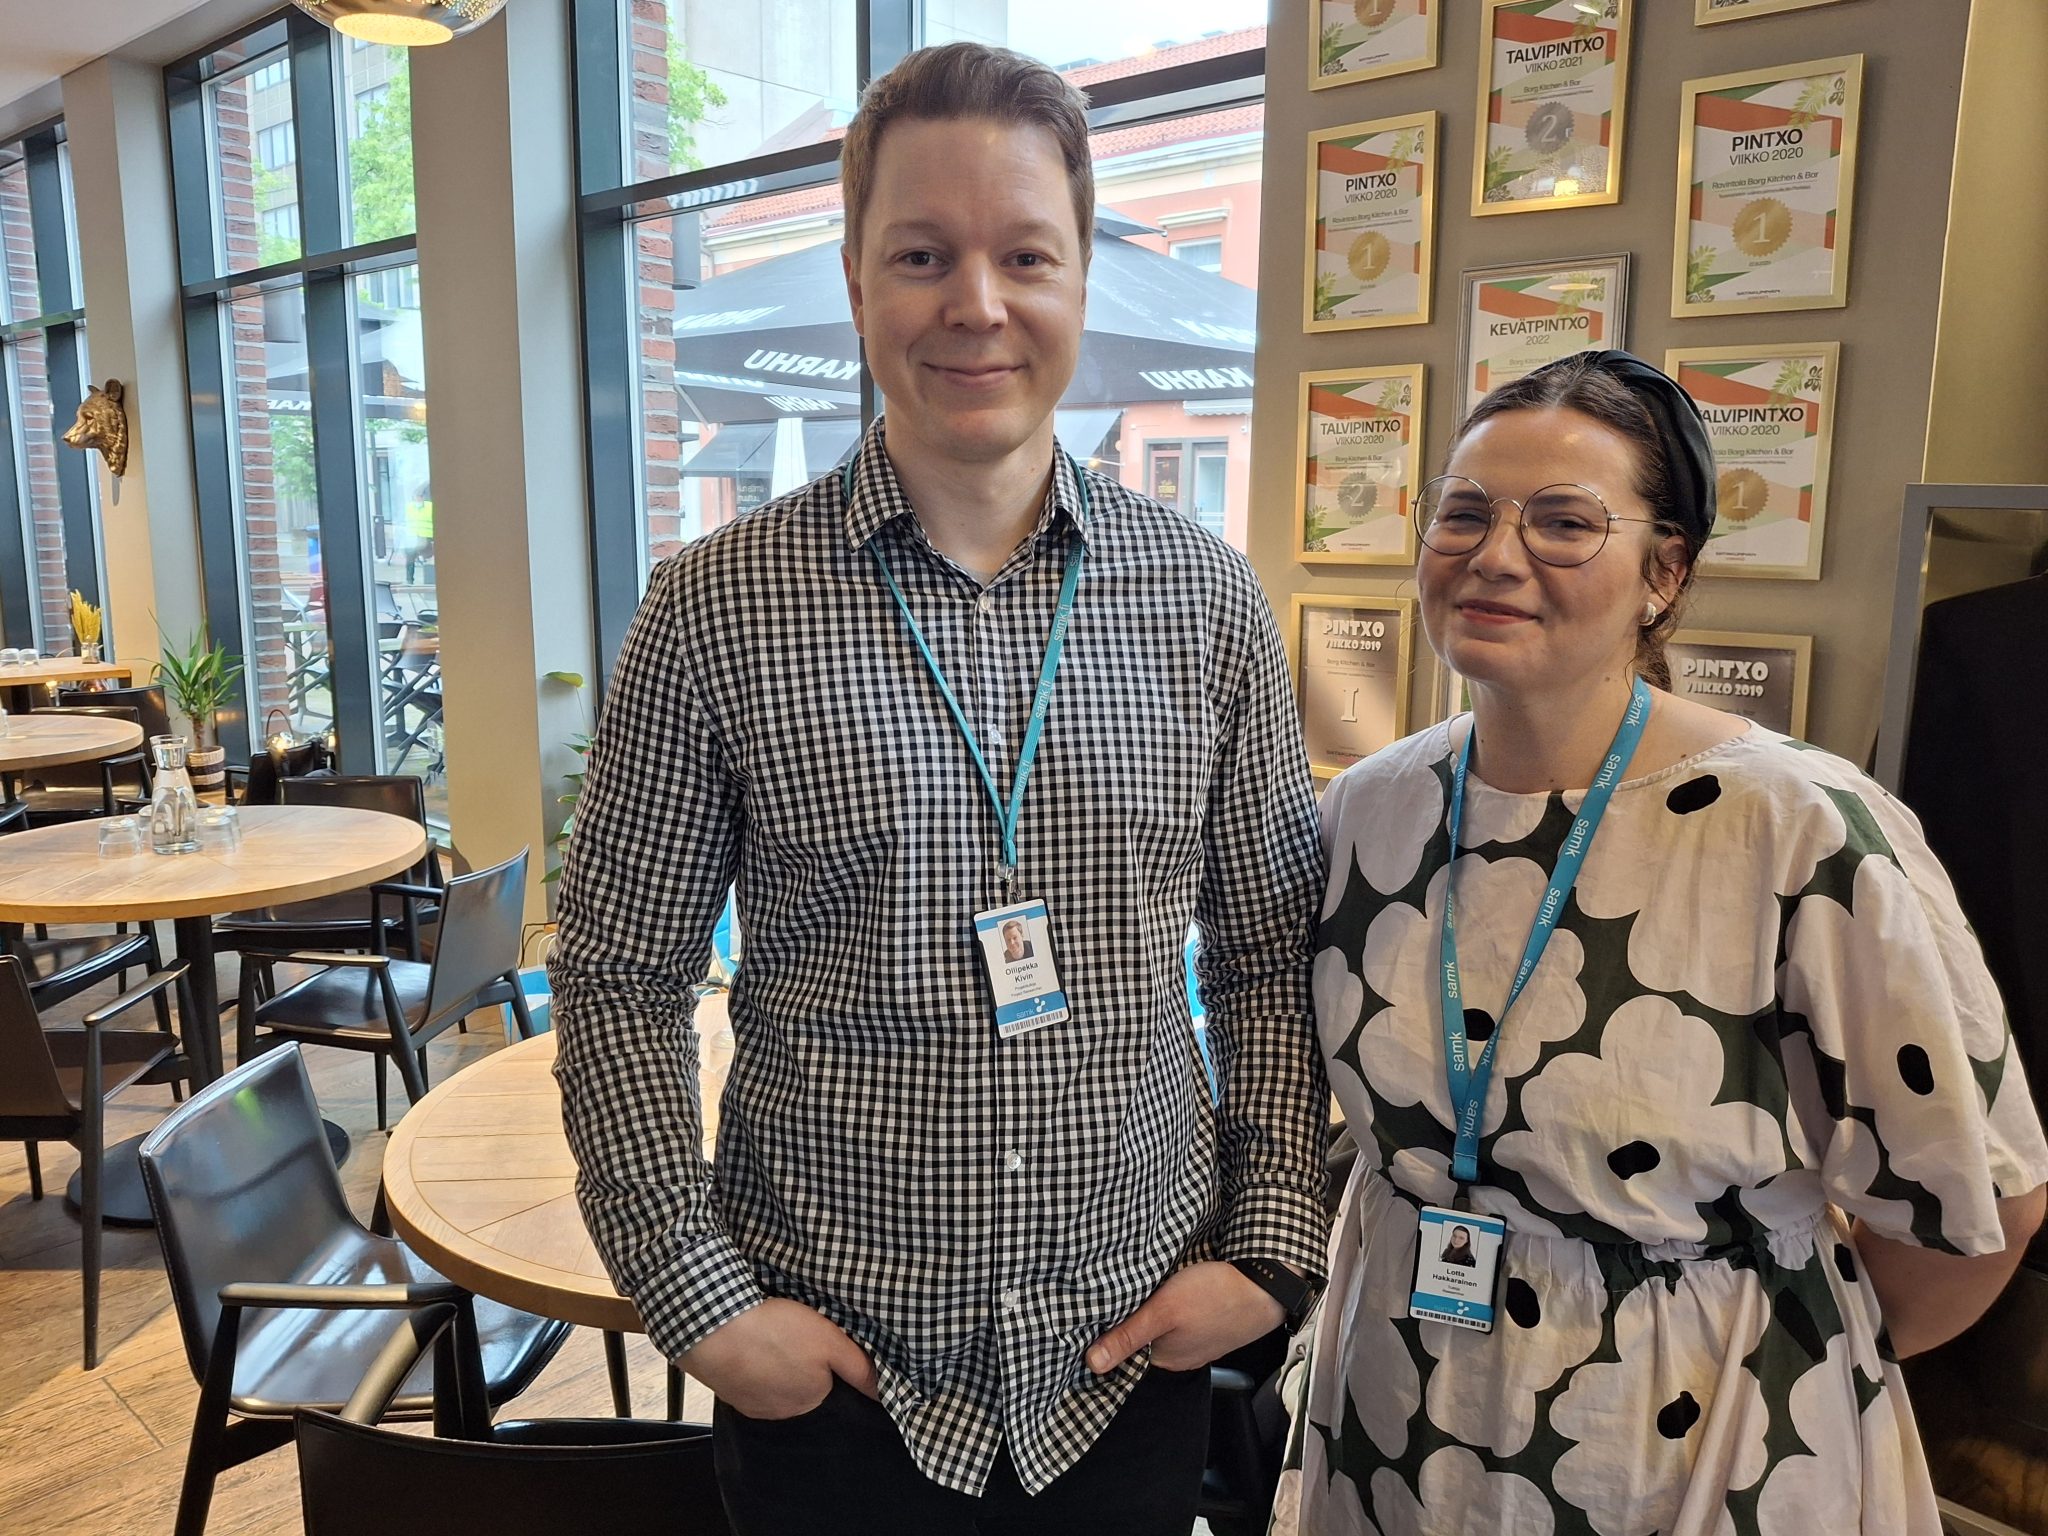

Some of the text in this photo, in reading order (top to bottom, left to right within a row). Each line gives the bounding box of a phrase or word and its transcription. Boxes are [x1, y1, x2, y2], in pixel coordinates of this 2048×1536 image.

[1506, 36, 1604, 64] TALVIPINTXO
[1525, 56, 1583, 74] VIIKKO 2021
[1541, 114, 1556, 142] 2
[1732, 128, 1803, 152] PINTXO
[1730, 147, 1804, 166] VIIKKO 2020
[1346, 172, 1396, 192] PINTXO
[1712, 171, 1819, 190] Ravintola Borg Kitchen & Bar
[1344, 188, 1398, 204] VIIKKO 2020
[1752, 212, 1771, 244] 1
[1362, 243, 1376, 270] 1
[1490, 316, 1590, 336] KEVÄTPINTXO
[1526, 334, 1550, 345] 2022
[1320, 420, 1400, 435] TALVIPINTXO
[1712, 424, 1780, 436] VIIKKO 2020
[1335, 434, 1384, 446] VIIKKO 2020
[1727, 448, 1744, 456] Borg
[1352, 484, 1364, 506] 2
[1732, 480, 1748, 510] 1
[1322, 618, 1385, 638] PINTXO
[1360, 640, 1382, 652] 2019
[1680, 658, 1769, 681] PINTXO
[1734, 684, 1764, 697] 2019
[1626, 693, 1644, 726] samk
[1594, 754, 1621, 790] samk
[1565, 818, 1590, 858] samk
[1538, 888, 1560, 928] samk
[1014, 973, 1034, 983] Kivin
[1444, 960, 1458, 998] samk
[1512, 958, 1532, 996] samk
[1448, 1032, 1464, 1072] samk
[1462, 1100, 1478, 1139] samk
[1432, 1274, 1478, 1288] Hakkarainen
[1446, 1268, 1464, 1278] Lotta
